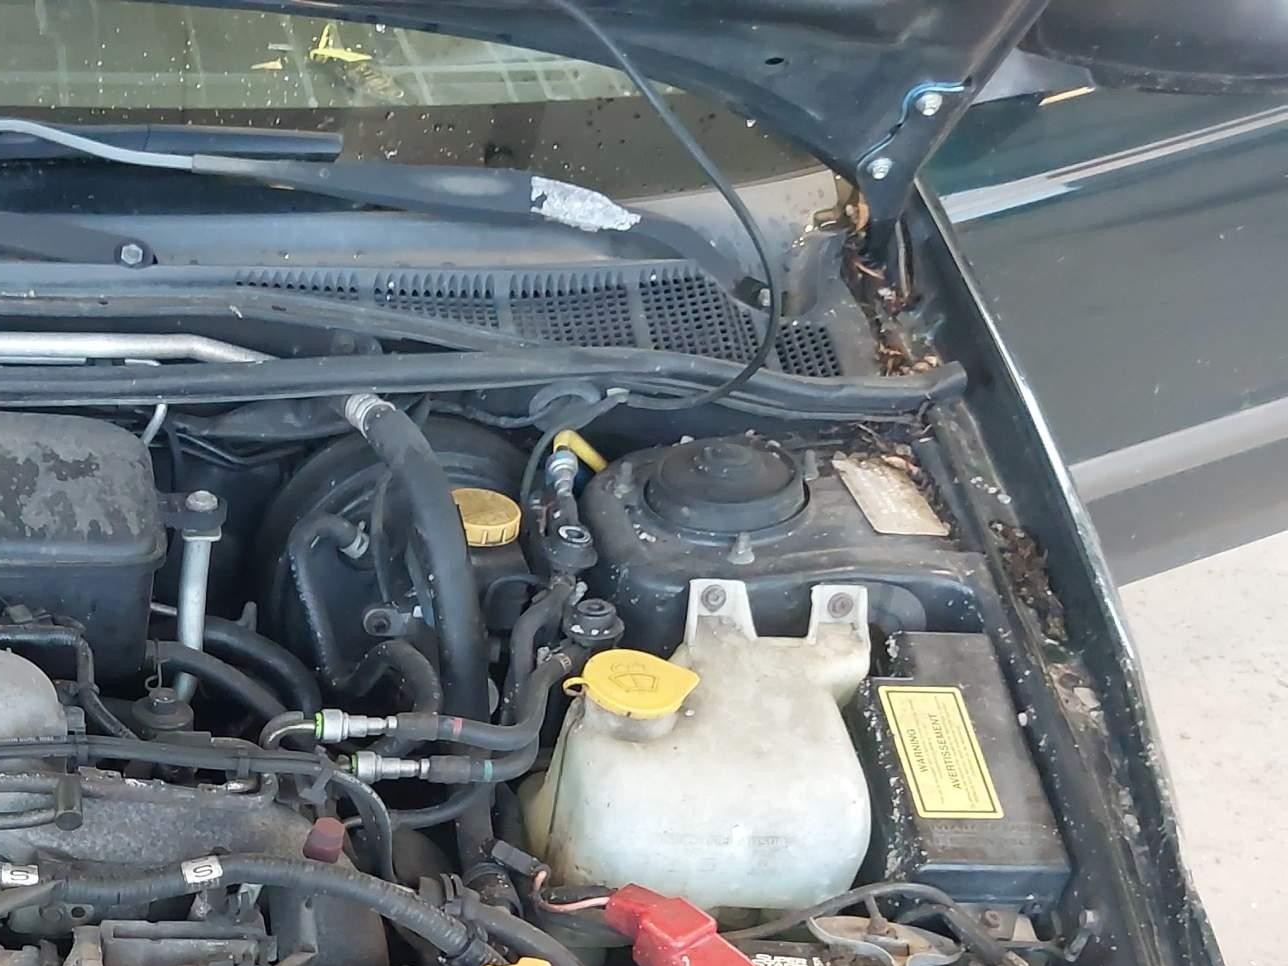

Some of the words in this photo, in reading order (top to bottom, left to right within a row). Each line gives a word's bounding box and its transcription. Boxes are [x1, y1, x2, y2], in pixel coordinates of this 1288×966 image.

[907, 728, 929, 773] WARNING
[928, 713, 963, 790] AVERTISSEMENT
[193, 864, 214, 878] S
